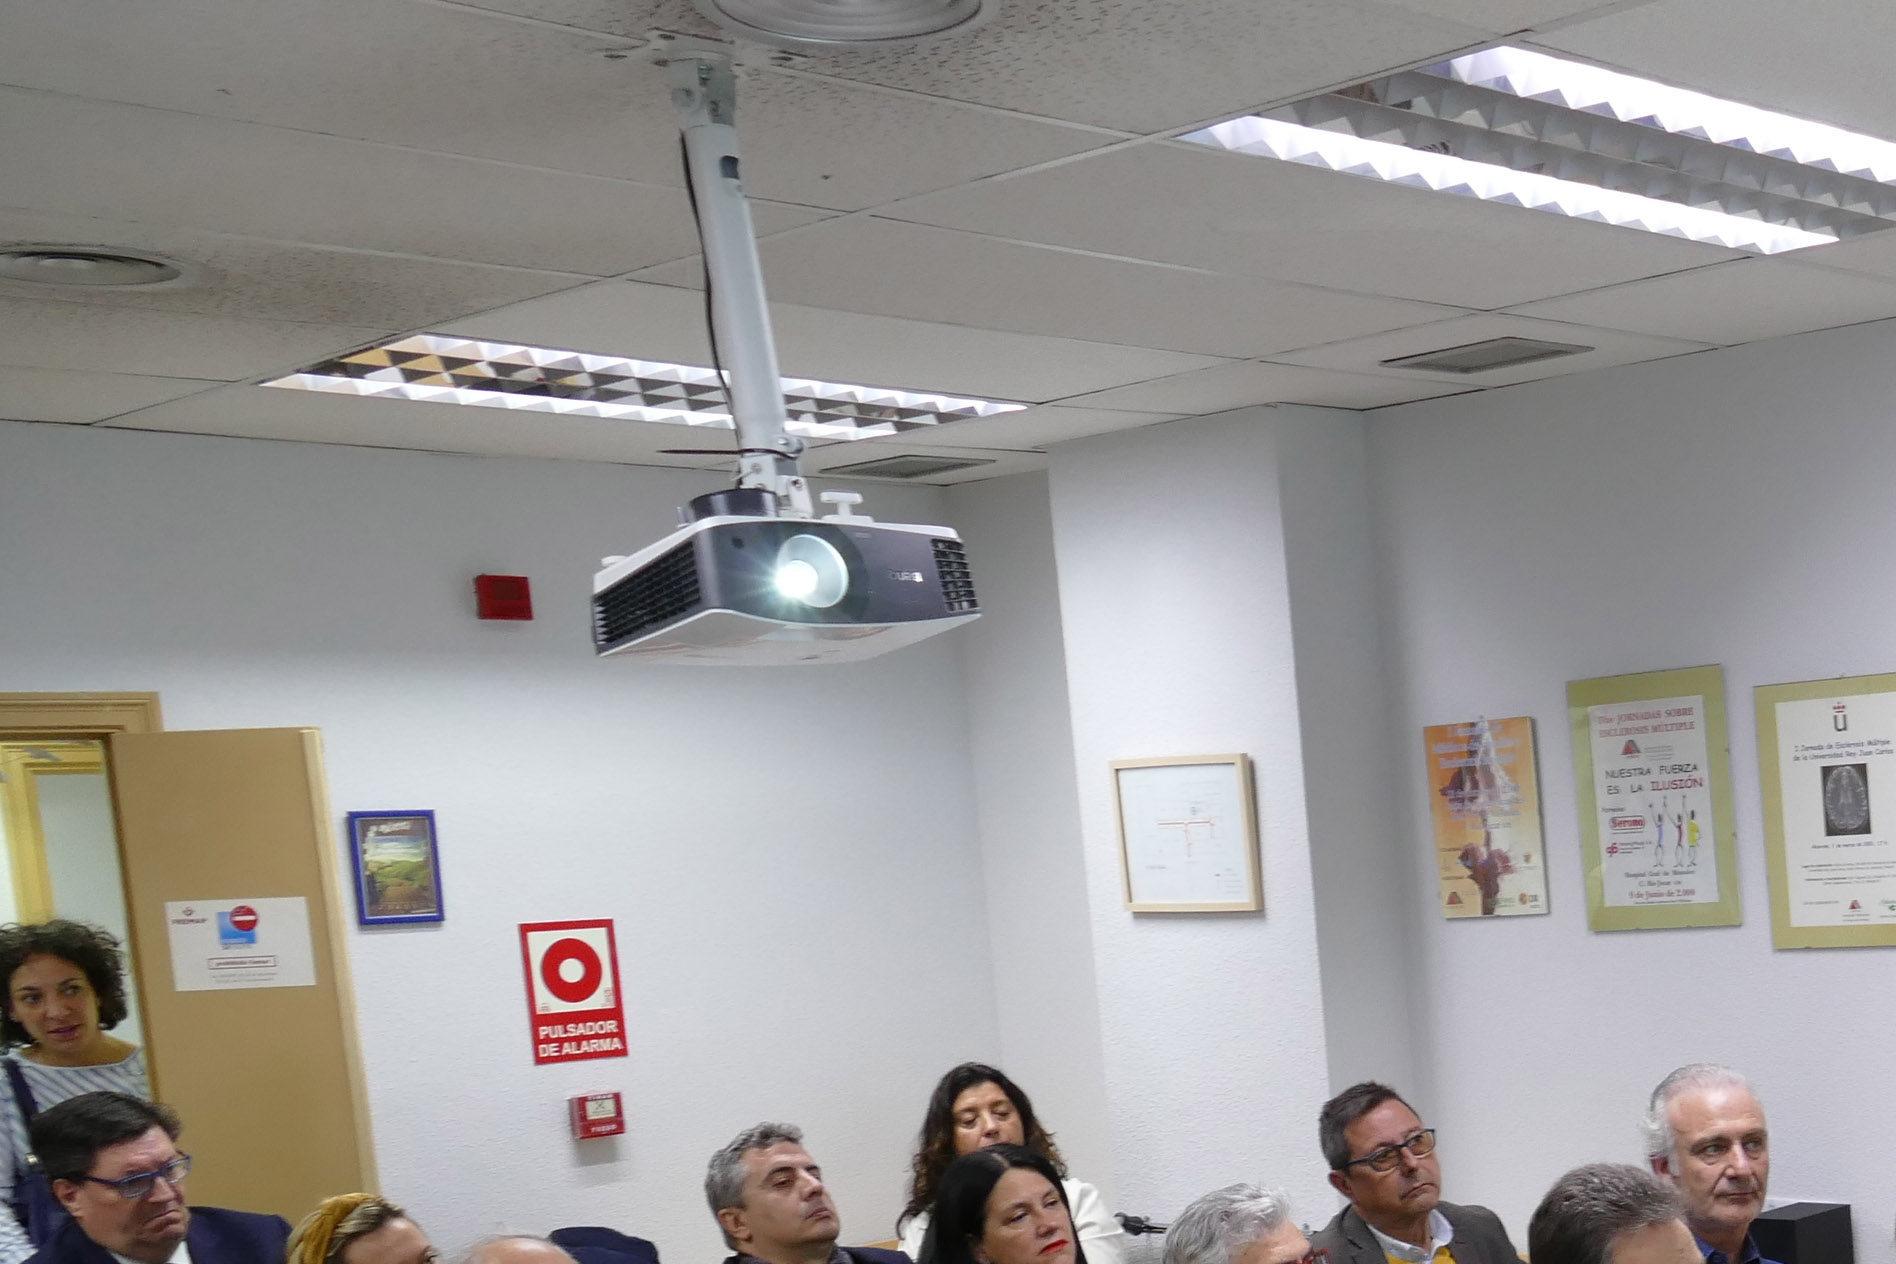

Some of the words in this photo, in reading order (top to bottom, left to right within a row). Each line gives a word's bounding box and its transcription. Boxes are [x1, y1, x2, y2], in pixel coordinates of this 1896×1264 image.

[1665, 707, 1693, 717] SOBRE
[1605, 767, 1651, 779] NUESTRA
[1659, 763, 1698, 775] FUERZA
[1606, 785, 1620, 795] ES
[1630, 783, 1643, 793] LA
[1650, 774, 1703, 791] ILUSIÓN
[538, 1020, 619, 1039] PULSADOR
[538, 1043, 560, 1057] DE
[561, 1037, 625, 1055] ALARMA
